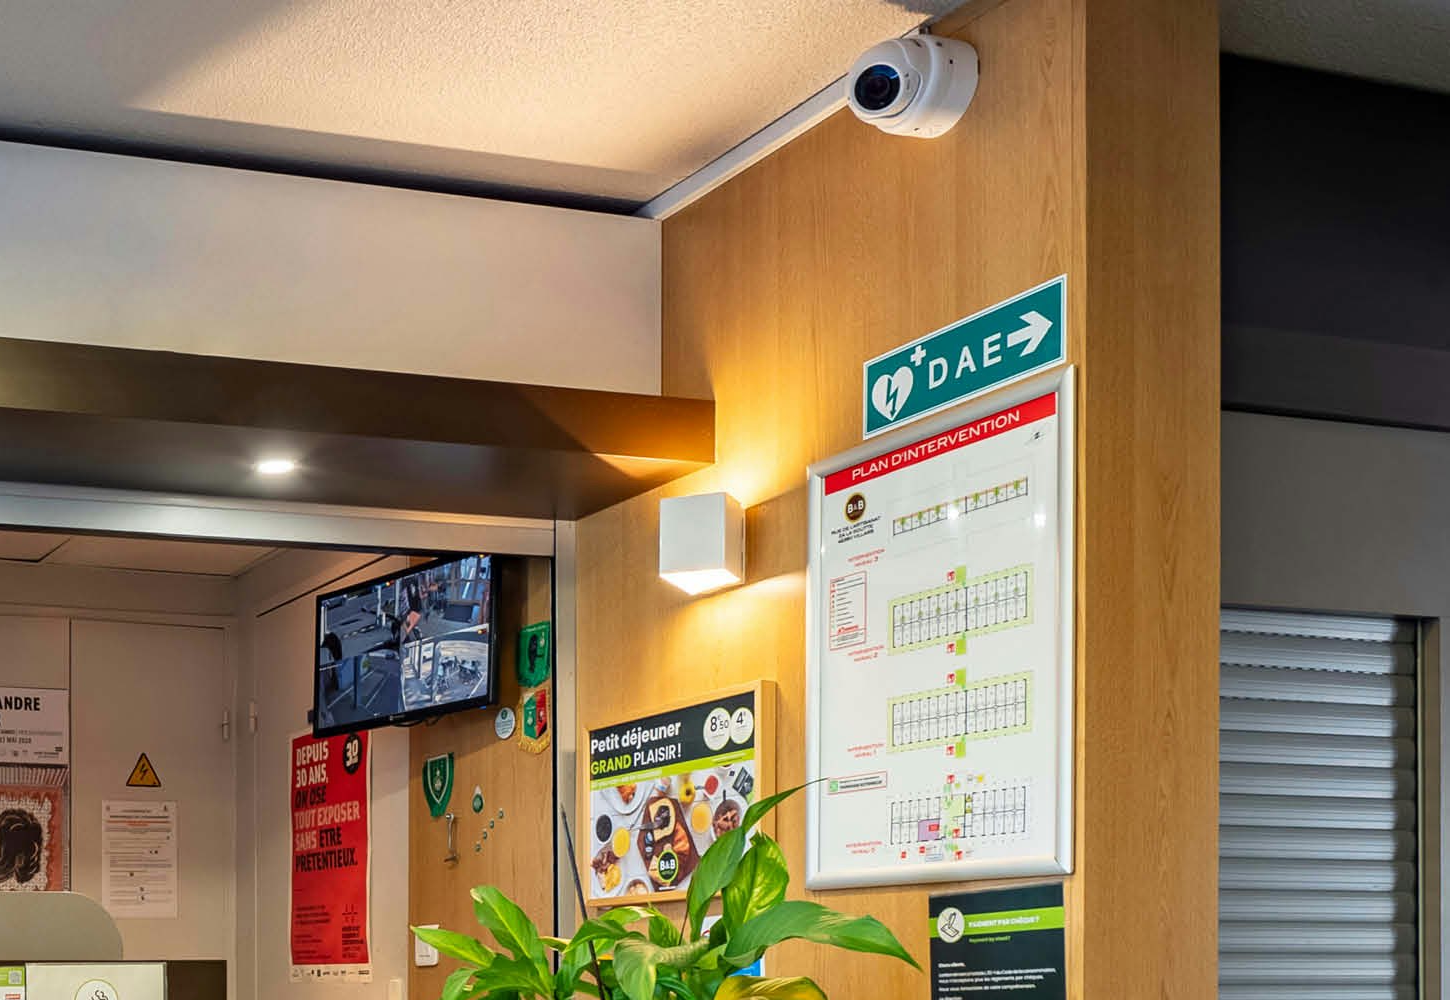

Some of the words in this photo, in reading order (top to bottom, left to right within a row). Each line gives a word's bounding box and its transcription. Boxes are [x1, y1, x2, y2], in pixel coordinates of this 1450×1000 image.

[928, 332, 1002, 390] DAE
[851, 453, 889, 481] PLAN
[891, 410, 1020, 468] D'INTERVENTION
[847, 500, 864, 514] B&B
[590, 733, 620, 754] Petit
[621, 721, 682, 749] déjeuner
[295, 740, 329, 767] DEPUIS
[591, 754, 632, 775] GRAND
[633, 745, 677, 767] PLAISIR
[677, 743, 682, 758] !
[295, 768, 308, 788] 30
[294, 789, 309, 808] ON
[309, 785, 327, 806] OSE
[294, 808, 316, 831] TOUT
[295, 830, 317, 852] SANS
[659, 858, 676, 871] B&B
